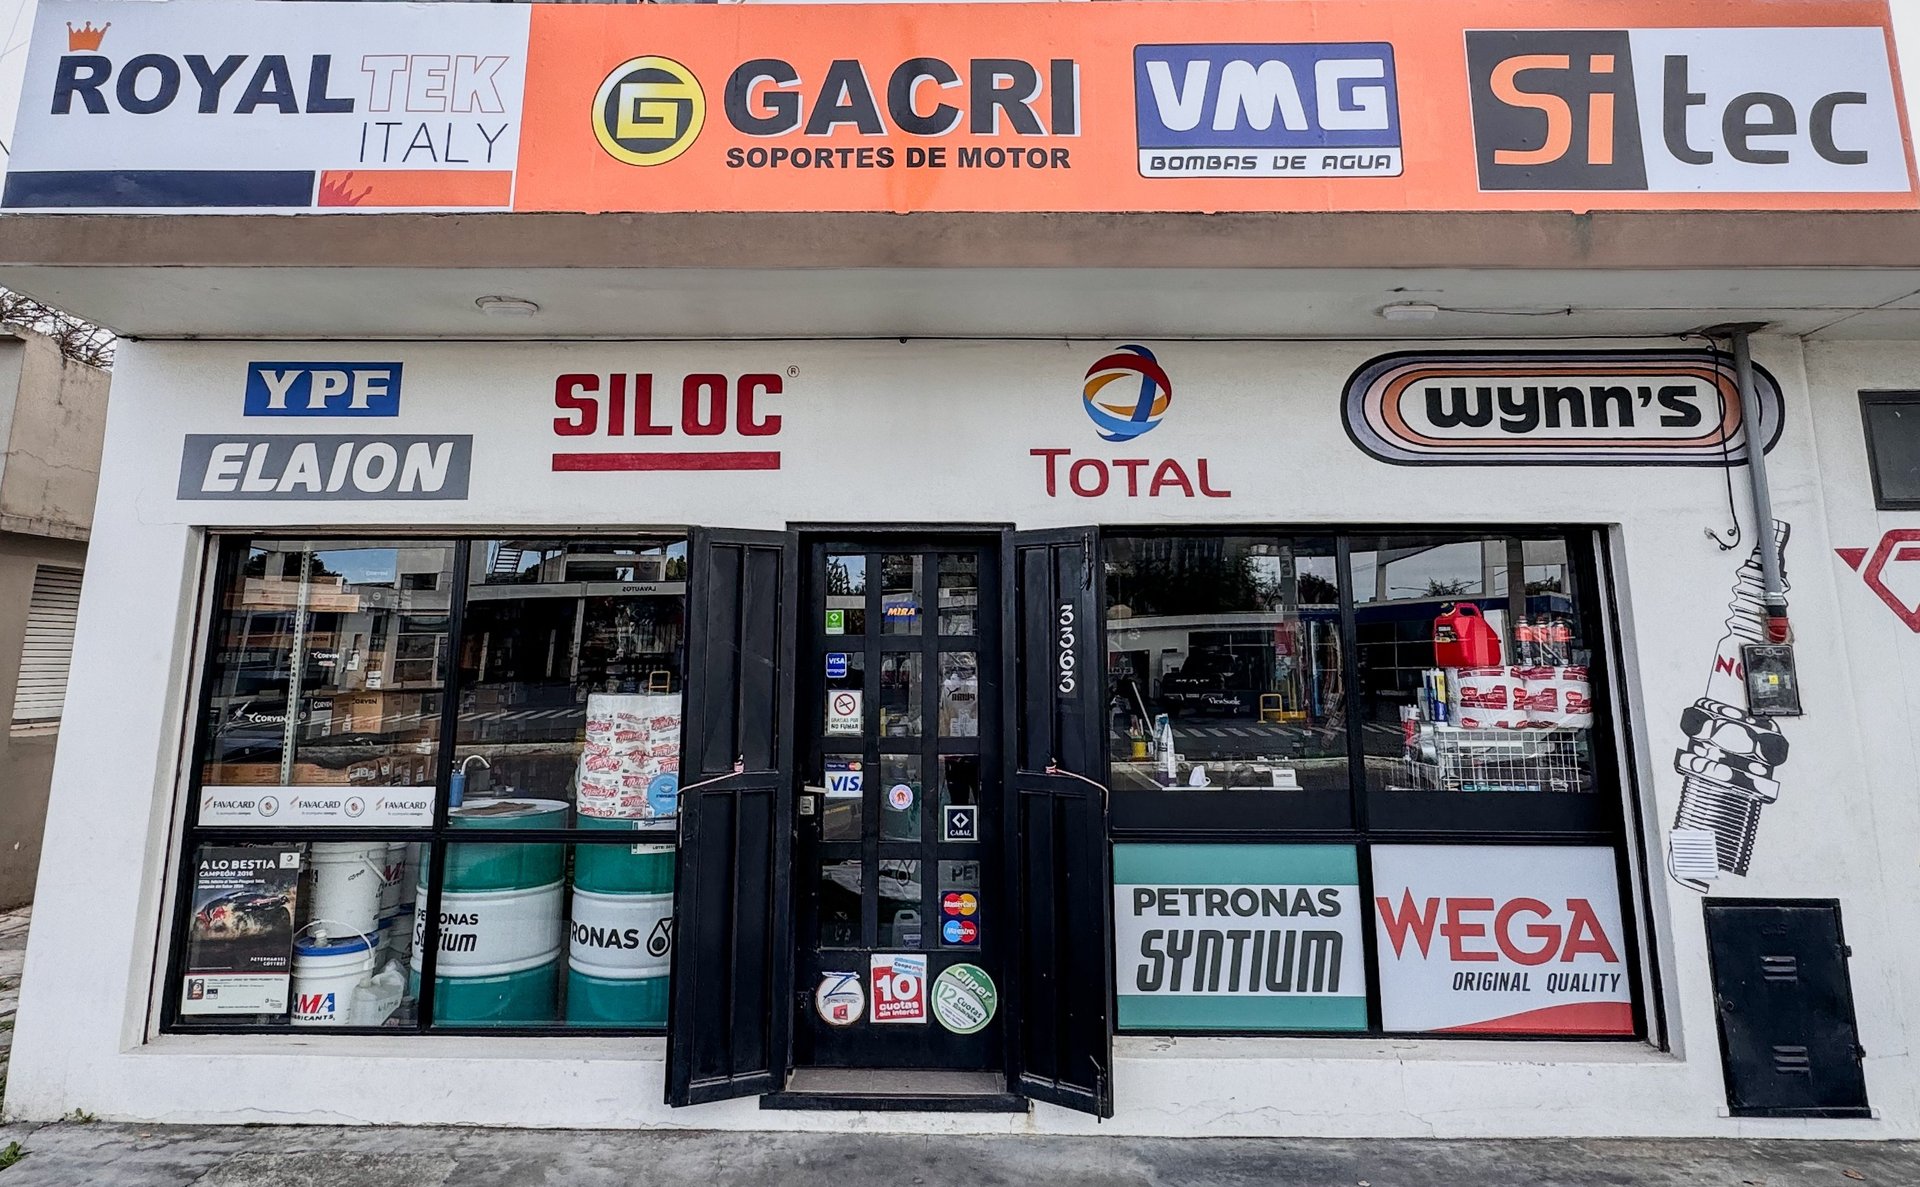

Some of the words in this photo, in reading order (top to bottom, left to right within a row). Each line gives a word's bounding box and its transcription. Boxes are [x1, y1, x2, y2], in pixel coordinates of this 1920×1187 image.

[724, 57, 1081, 137] GACRI
[1146, 59, 1389, 131] VMG
[358, 122, 509, 163] ITALY
[726, 147, 895, 169] SOPORTES
[906, 147, 947, 168] DE
[958, 147, 1072, 169] MOTOR
[1150, 155, 1257, 170] BOMBAS
[1272, 155, 1307, 170] DE
[1322, 155, 1391, 170] AGUA
[257, 369, 391, 409] YPF
[553, 373, 783, 436] SILOC
[201, 442, 454, 493] ELAION
[1030, 448, 1232, 498] TOTAL
[887, 608, 916, 616] MIRA
[1059, 604, 1076, 693] 3363
[828, 657, 845, 665] VISA
[830, 775, 864, 792] VIS
[213, 800, 255, 809] FAVACARD
[298, 800, 341, 809] FAVACARD
[384, 801, 427, 810] FAVACARD
[949, 829, 972, 837] CABAL
[198, 869, 236, 877] CAMPEÓN
[199, 860, 210, 870] A
[211, 860, 229, 870] LO
[231, 859, 276, 870] BESTIA
[1133, 887, 1342, 918] PETRONAS
[418, 908, 479, 926] PEONAS
[1375, 886, 1620, 966] WEGA
[1136, 929, 1344, 993] SYNTIUM
[876, 973, 918, 1001] 10
[1452, 971, 1531, 993] ORIGINAL
[1546, 971, 1621, 993] QUALITY
[939, 984, 957, 1005] 12
[878, 1001, 920, 1011] cuotas
[957, 997, 982, 1019] Cuotas
